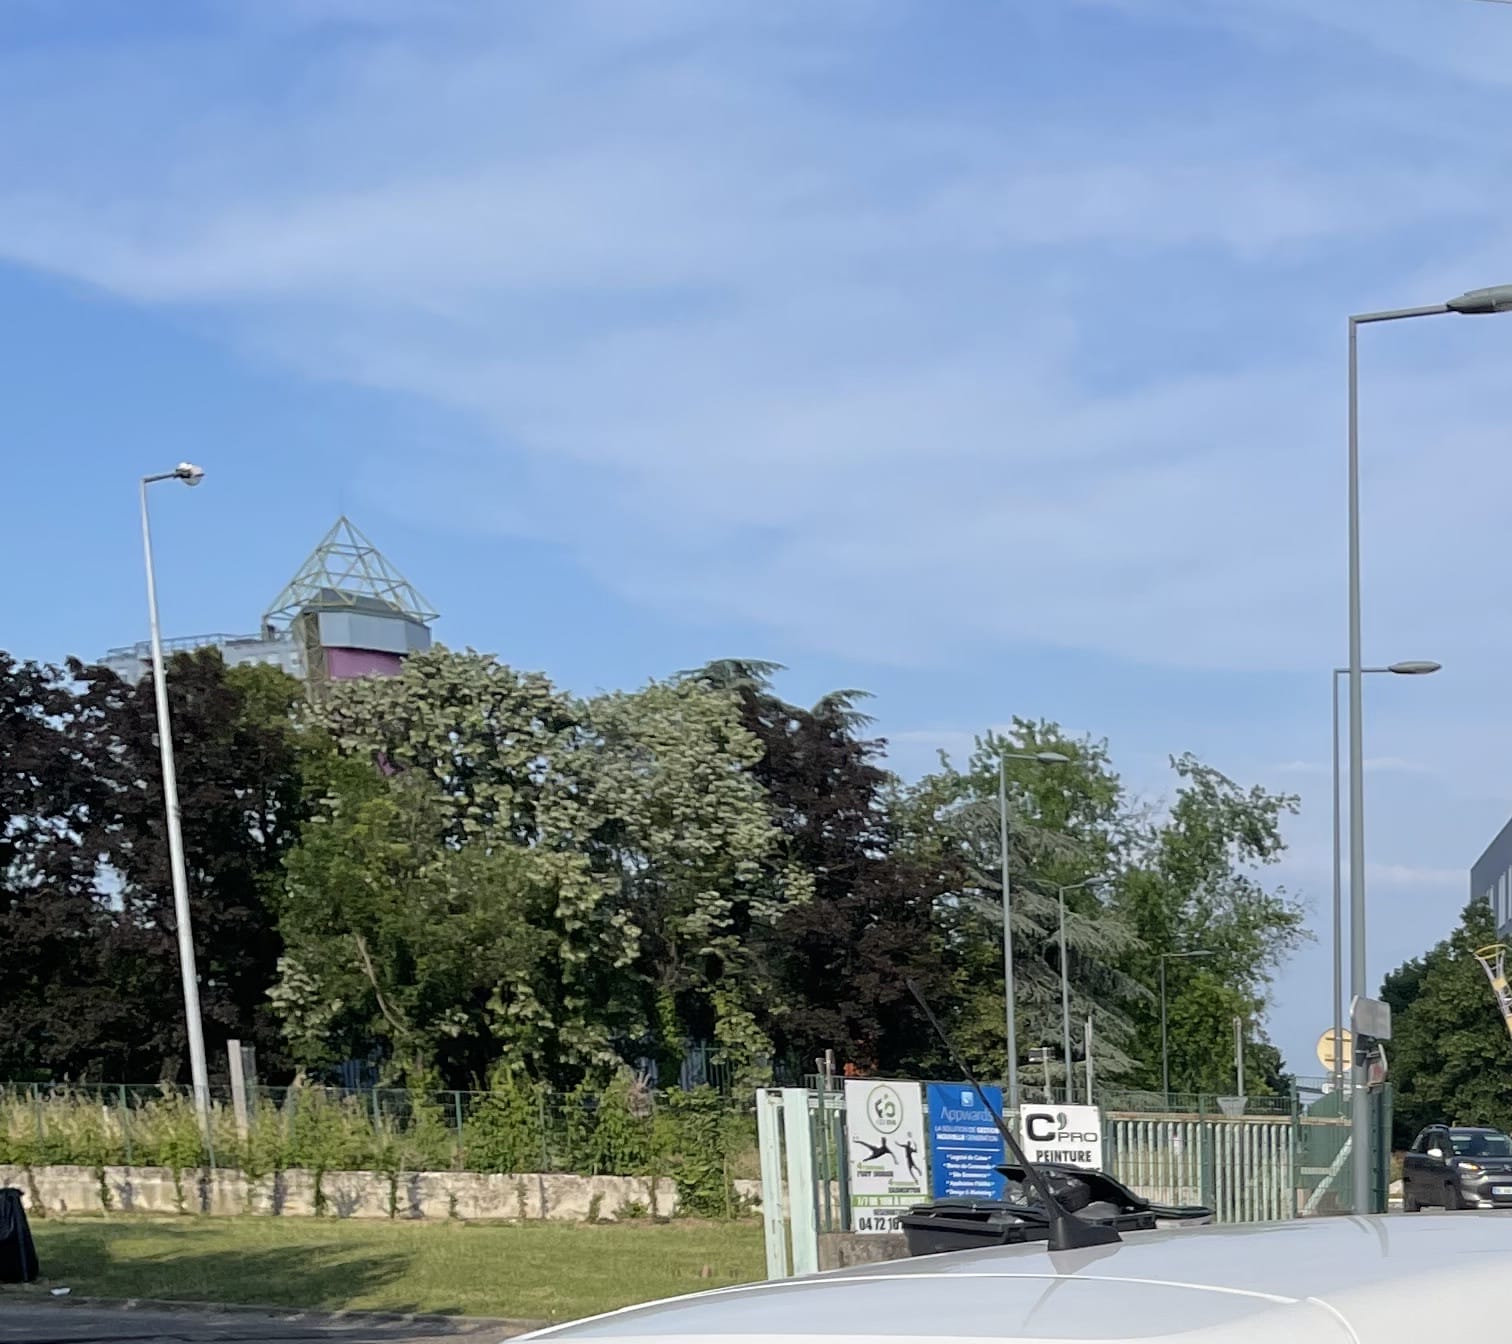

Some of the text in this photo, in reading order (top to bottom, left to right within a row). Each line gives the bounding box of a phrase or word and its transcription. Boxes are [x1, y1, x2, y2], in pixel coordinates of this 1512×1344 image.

[1036, 1150, 1092, 1162] PEINTURE
[859, 1217, 872, 1231] 04
[874, 1217, 886, 1231] 72
